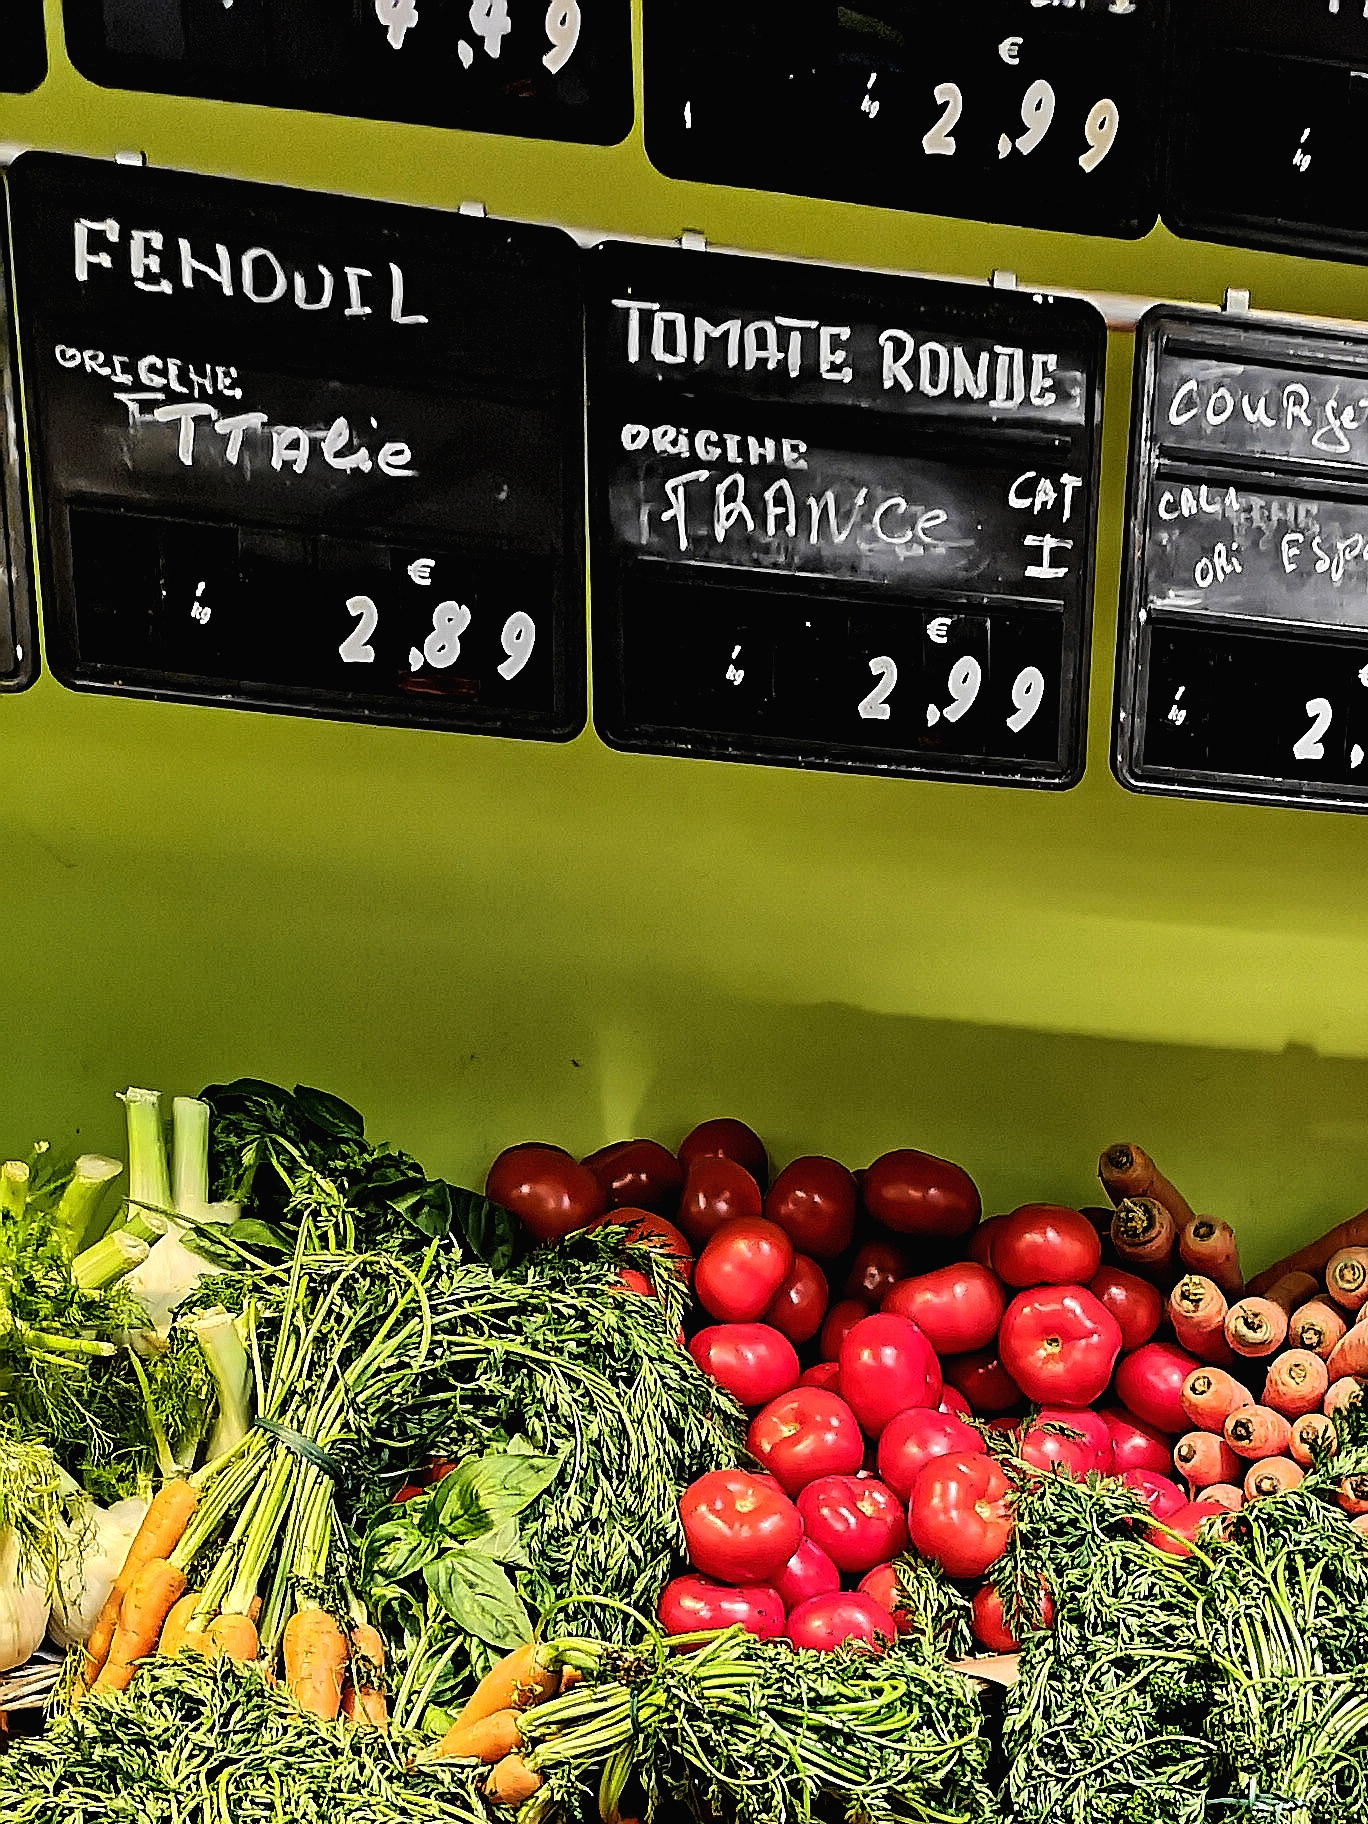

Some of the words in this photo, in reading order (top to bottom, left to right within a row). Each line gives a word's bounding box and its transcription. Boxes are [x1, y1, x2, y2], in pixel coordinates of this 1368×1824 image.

[922, 79, 1119, 173] 2,99
[74, 218, 428, 324] FENOUIL
[611, 299, 853, 383] TOMATE
[879, 329, 1058, 409] RONDE
[1008, 472, 1082, 522] CAT
[339, 595, 535, 680] 2,89
[858, 655, 1044, 732] 2,99
